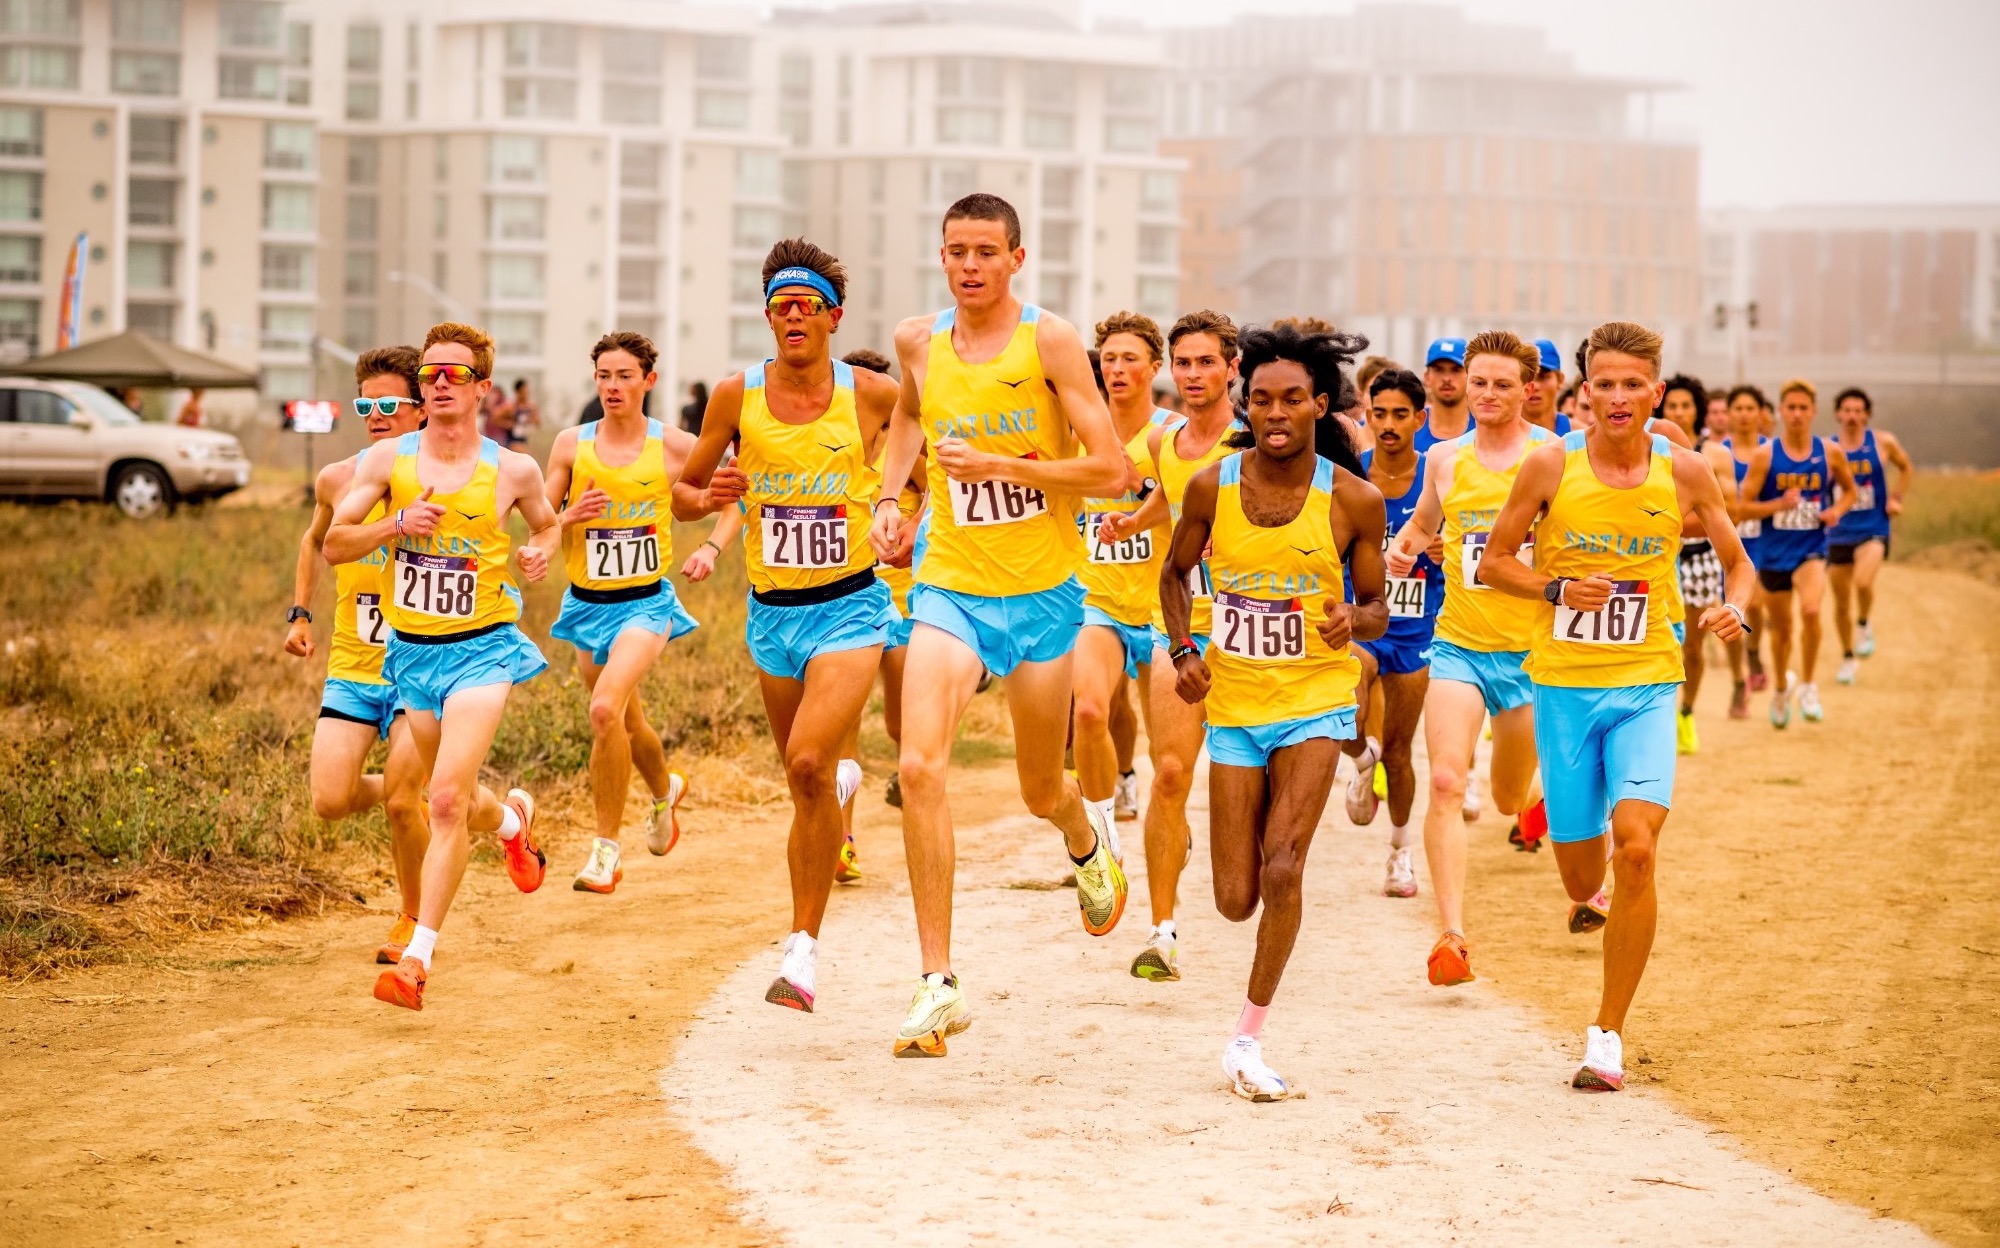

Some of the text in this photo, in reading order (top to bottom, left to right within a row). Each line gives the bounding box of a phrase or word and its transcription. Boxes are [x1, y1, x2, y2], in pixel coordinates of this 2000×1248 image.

[775, 270, 796, 281] HOKA
[936, 408, 1038, 438] SALT LAKE
[753, 472, 848, 494] SALT LAKE
[618, 500, 657, 519] LAKE
[961, 481, 1045, 522] 2164
[1458, 510, 1495, 527] SALT
[397, 534, 482, 556] SALT LAKE
[772, 520, 846, 565] 2165
[1565, 531, 1664, 555] SALT LAKE
[596, 537, 659, 577] 2170
[403, 566, 475, 616] 2158
[1221, 569, 1265, 591] SALT
[1269, 574, 1322, 594] LAKE
[1224, 608, 1303, 657] 2159
[1567, 597, 1647, 641] 2167
